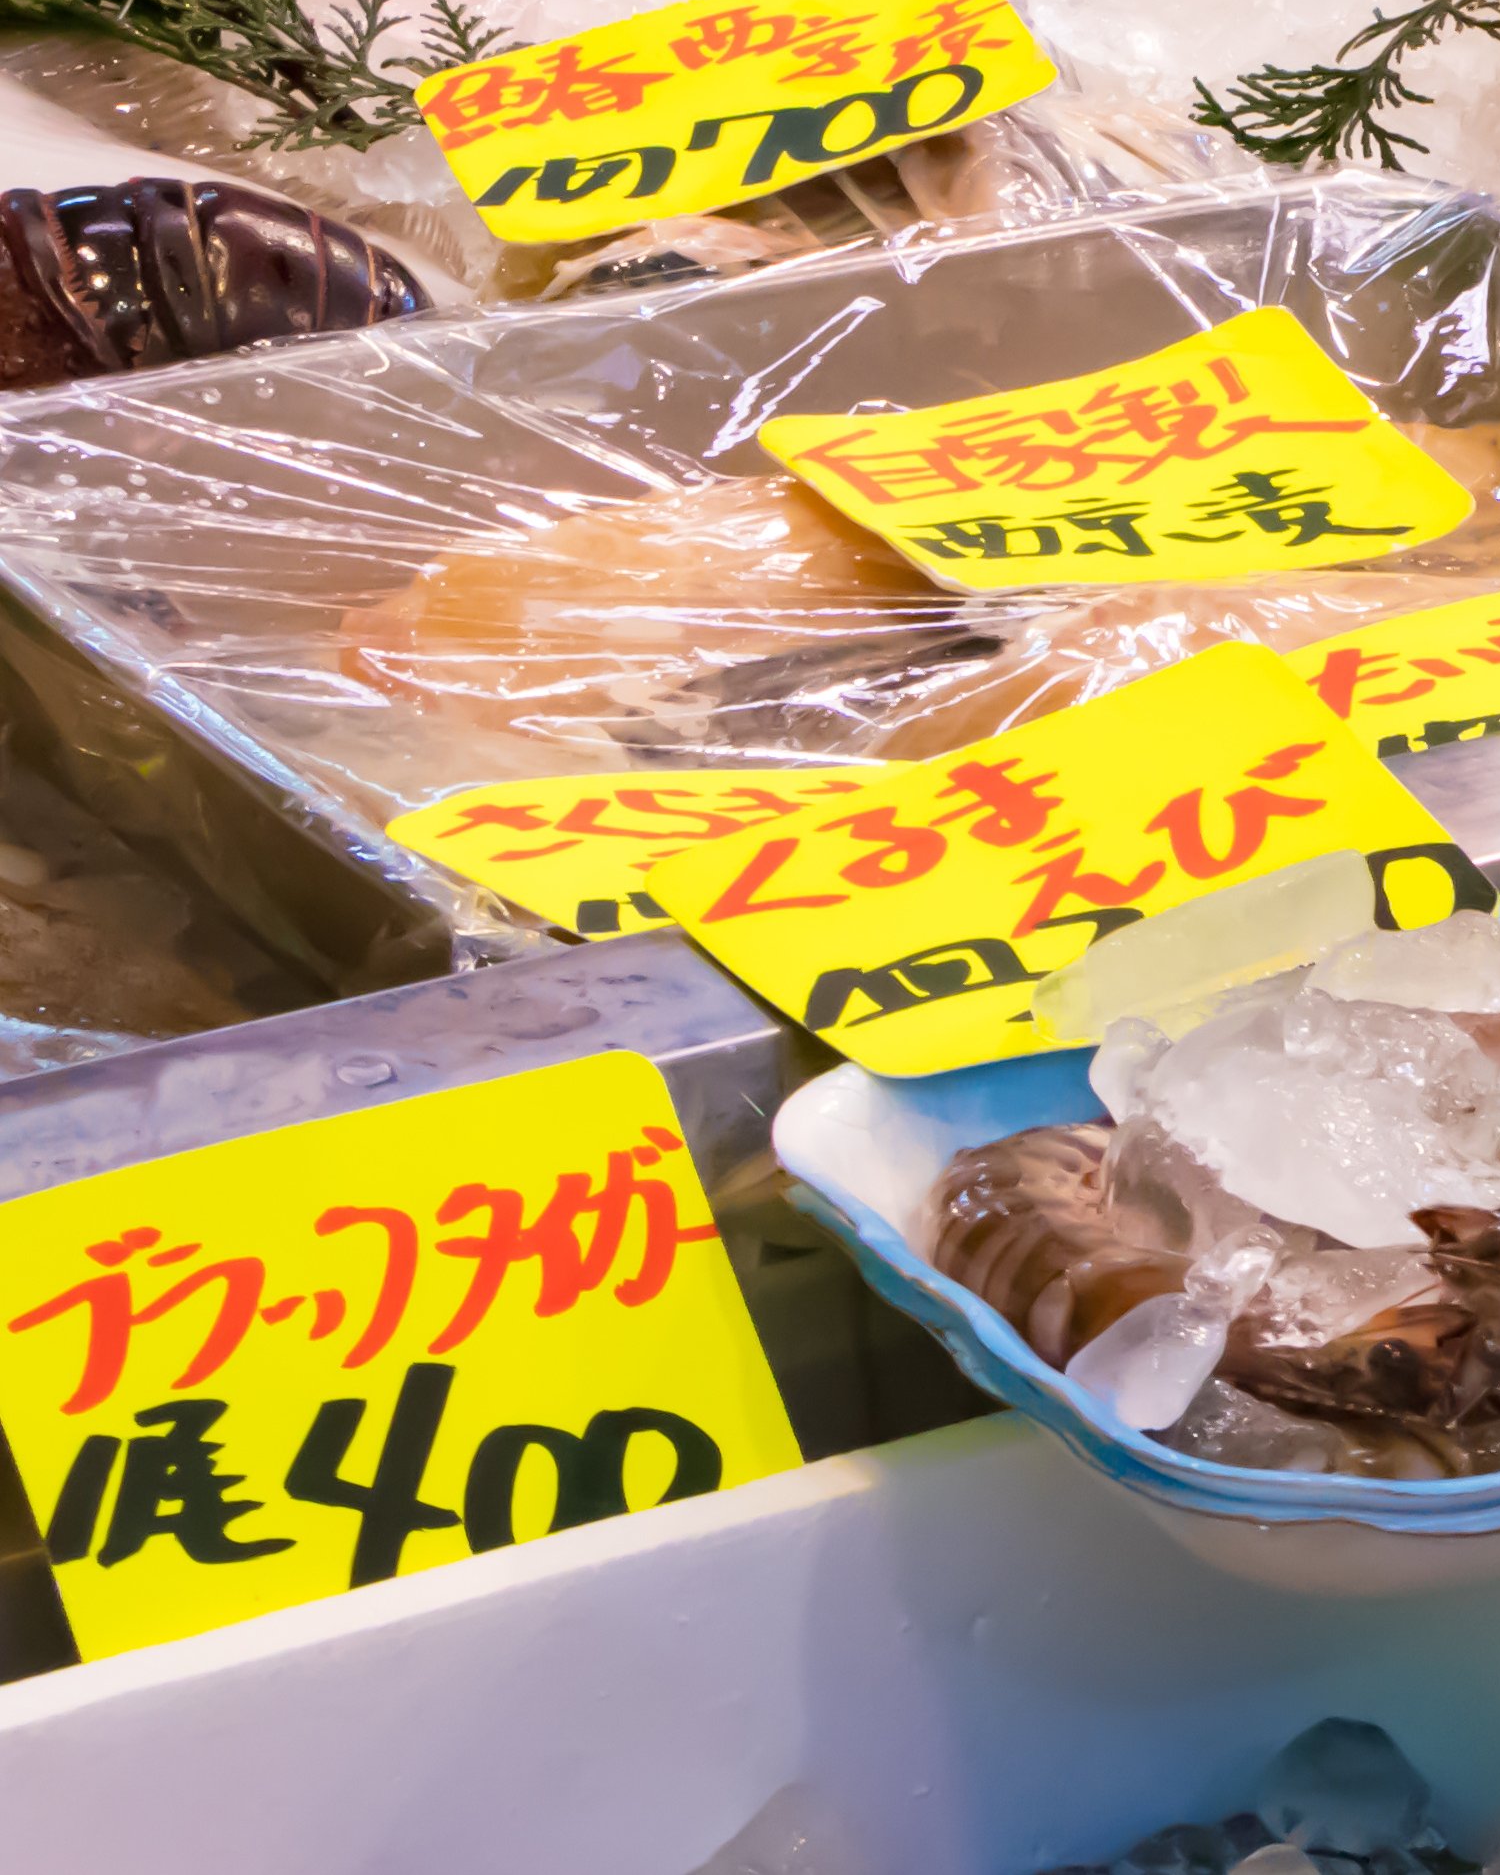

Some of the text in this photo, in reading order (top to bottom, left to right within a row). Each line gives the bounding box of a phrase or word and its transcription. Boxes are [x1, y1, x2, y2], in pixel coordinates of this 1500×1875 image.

[791, 356, 1371, 506] 自家製
[898, 467, 1416, 561] 西京漬
[697, 755, 1064, 924] くるま
[1012, 740, 1328, 940] えび
[5, 1125, 722, 1415] ブラックタイガー
